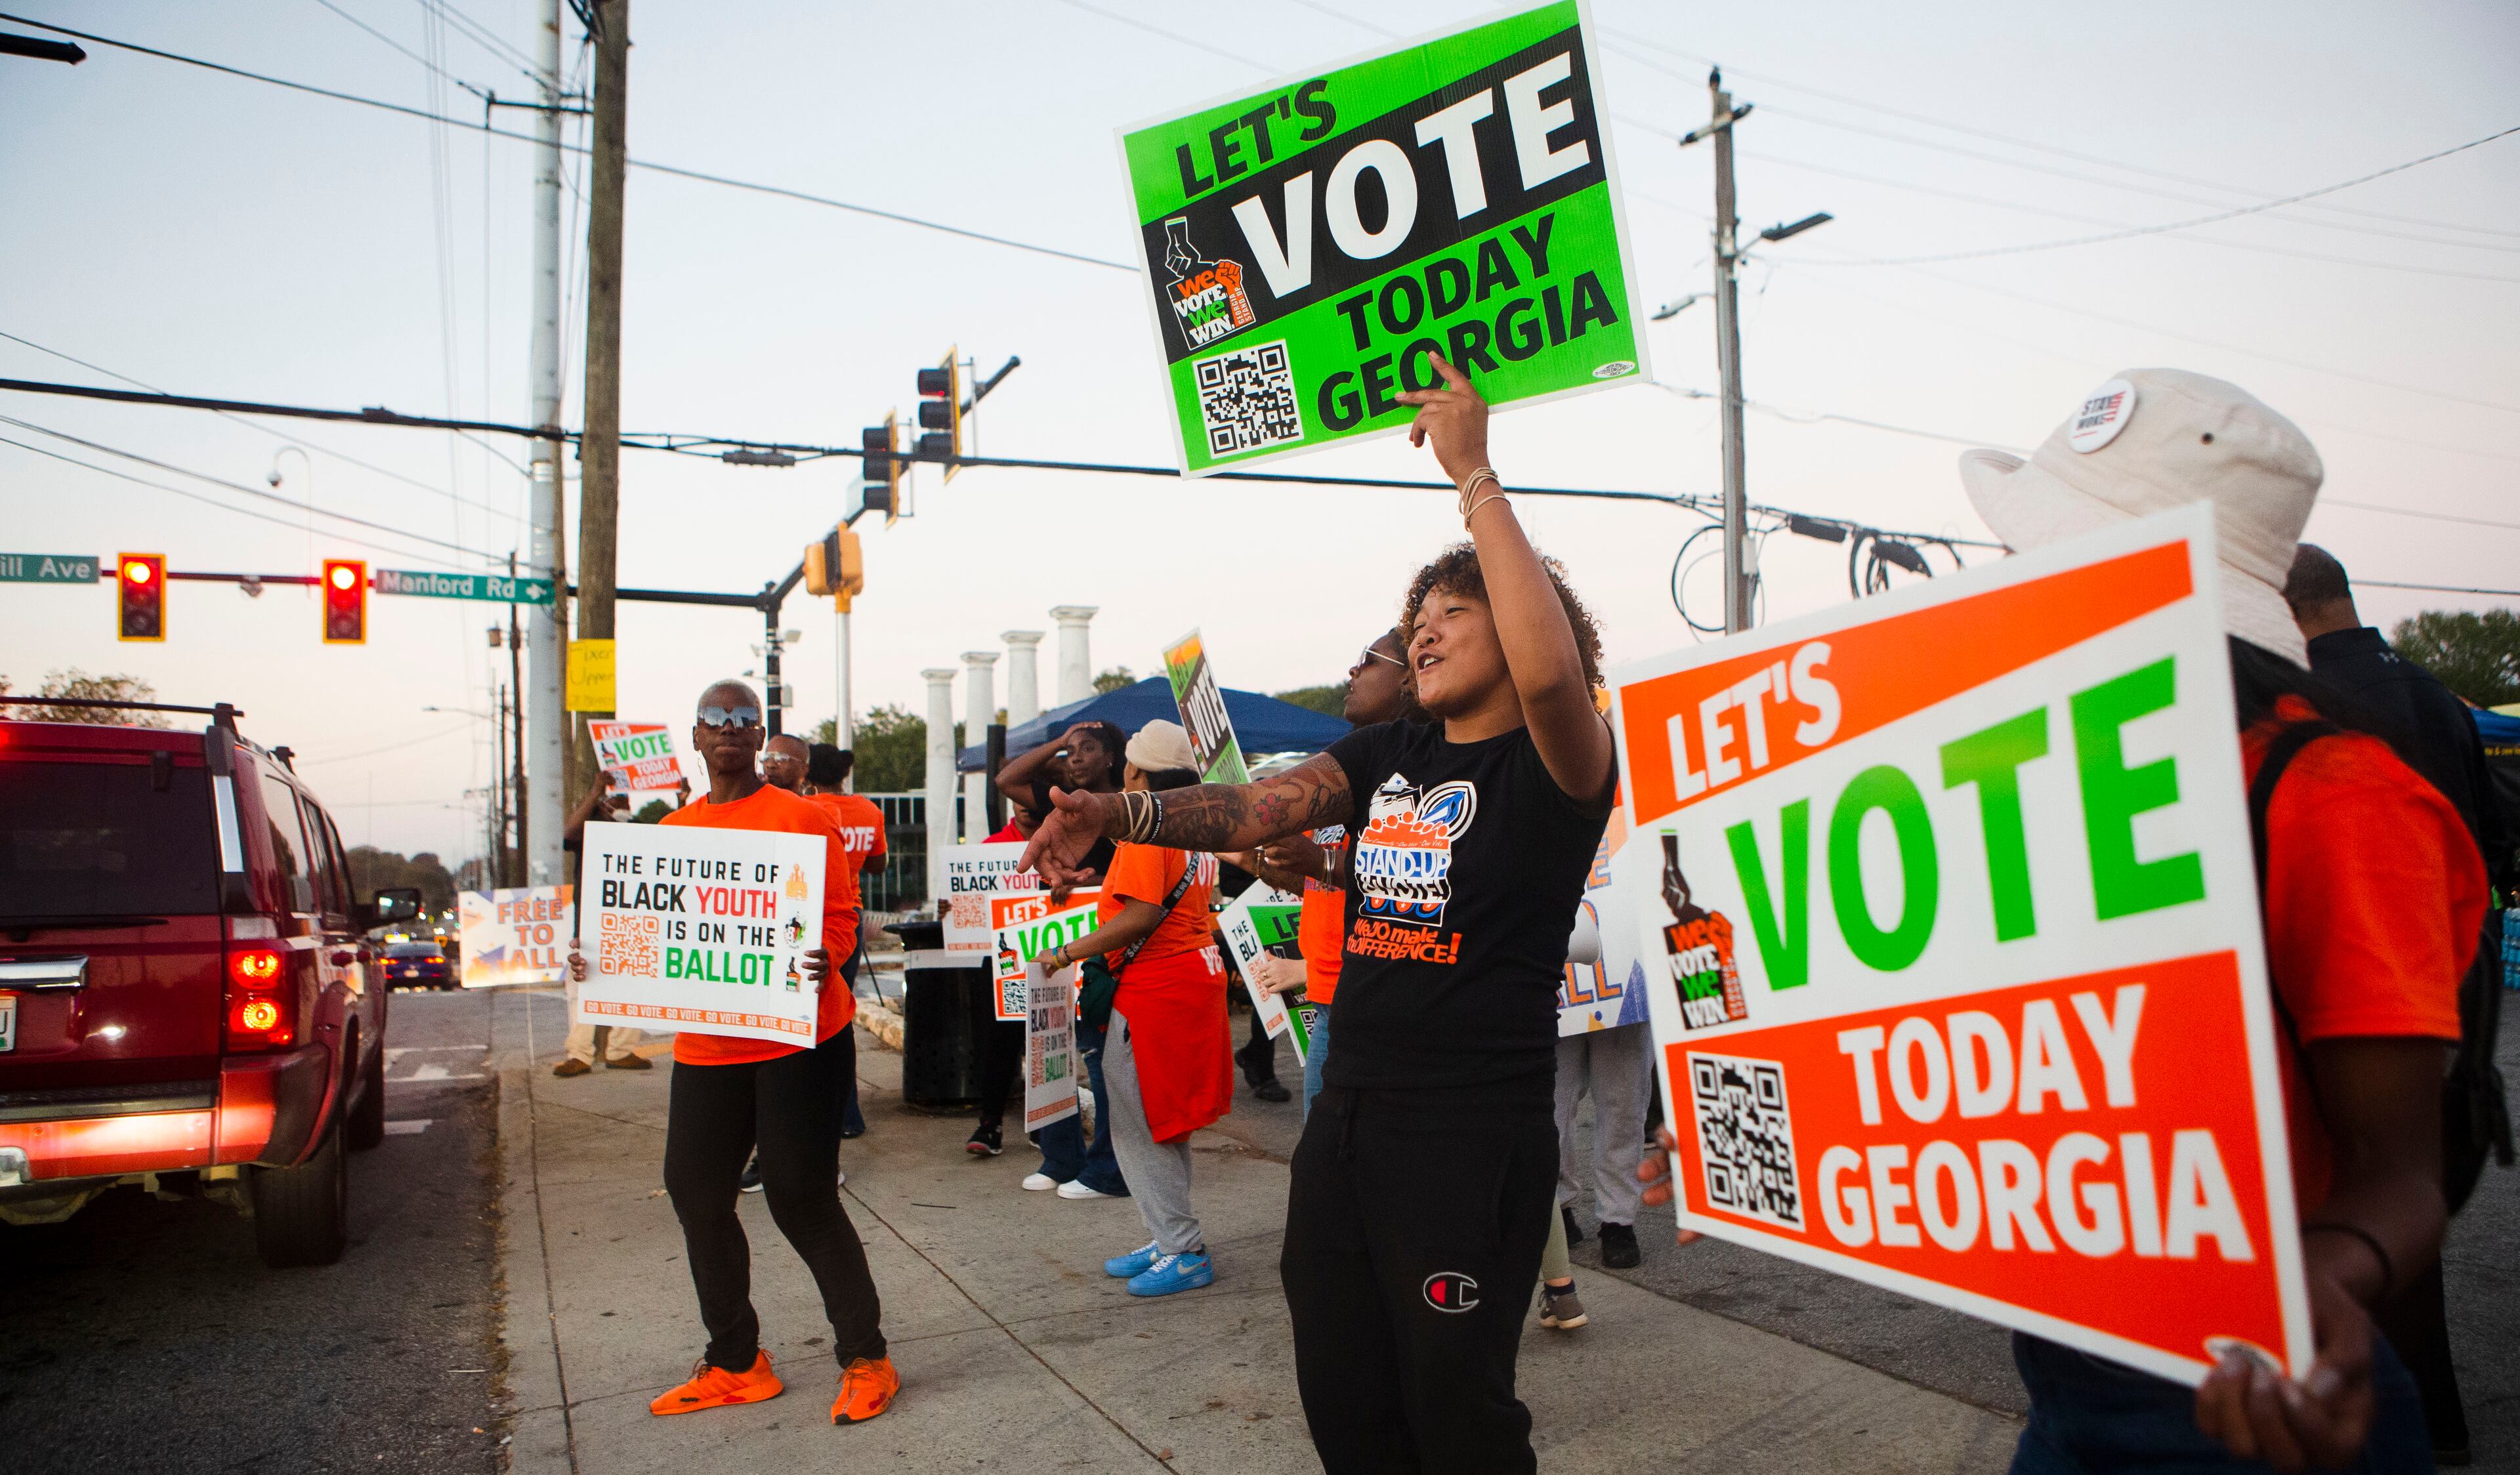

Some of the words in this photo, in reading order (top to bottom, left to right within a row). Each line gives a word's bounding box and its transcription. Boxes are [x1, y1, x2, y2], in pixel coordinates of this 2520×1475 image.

[1176, 80, 1336, 199] LET'S
[1232, 52, 1590, 299] VOTE
[1177, 269, 1215, 298] we
[1336, 213, 1555, 353] TODAY
[1188, 299, 1226, 327] we
[1229, 293, 1244, 325] GEORGIA
[1318, 271, 1619, 432] GEORGIA
[39, 558, 90, 579] Ave
[383, 571, 474, 596] Manford
[487, 578, 514, 598] Rd
[1186, 661, 1227, 758] VOTE
[1666, 641, 1841, 802] LET'S
[614, 734, 671, 761] VOTE
[1725, 656, 2206, 992] VOTE
[602, 854, 642, 874] THE
[656, 858, 742, 881] FUTURE
[755, 863, 780, 884] OF
[950, 863, 971, 873] THE
[980, 860, 1019, 871] FUTUR
[1356, 848, 1450, 877] STAND-UP
[952, 875, 998, 892] BLACK
[1003, 873, 1040, 890] YOUT
[497, 900, 563, 924] FREE
[602, 880, 686, 913] BLACK
[695, 886, 776, 919] YOUTH
[1003, 896, 1047, 926] LET'S
[514, 924, 553, 946] TO
[667, 920, 686, 940] IS
[699, 923, 724, 944] ON
[738, 925, 775, 947] THE
[1232, 920, 1249, 942] THE
[1670, 919, 1709, 951] we
[509, 947, 562, 969] ALL
[666, 947, 774, 986] BALLOT
[1681, 970, 1719, 1001] we
[587, 1001, 598, 1012] GO
[627, 1005, 638, 1016] GO
[666, 1008, 677, 1019] GO
[705, 1011, 717, 1022] GO
[746, 1015, 757, 1026] GO
[1838, 984, 2147, 1125] TODAY
[1818, 1129, 2256, 1261] GEORGIA
